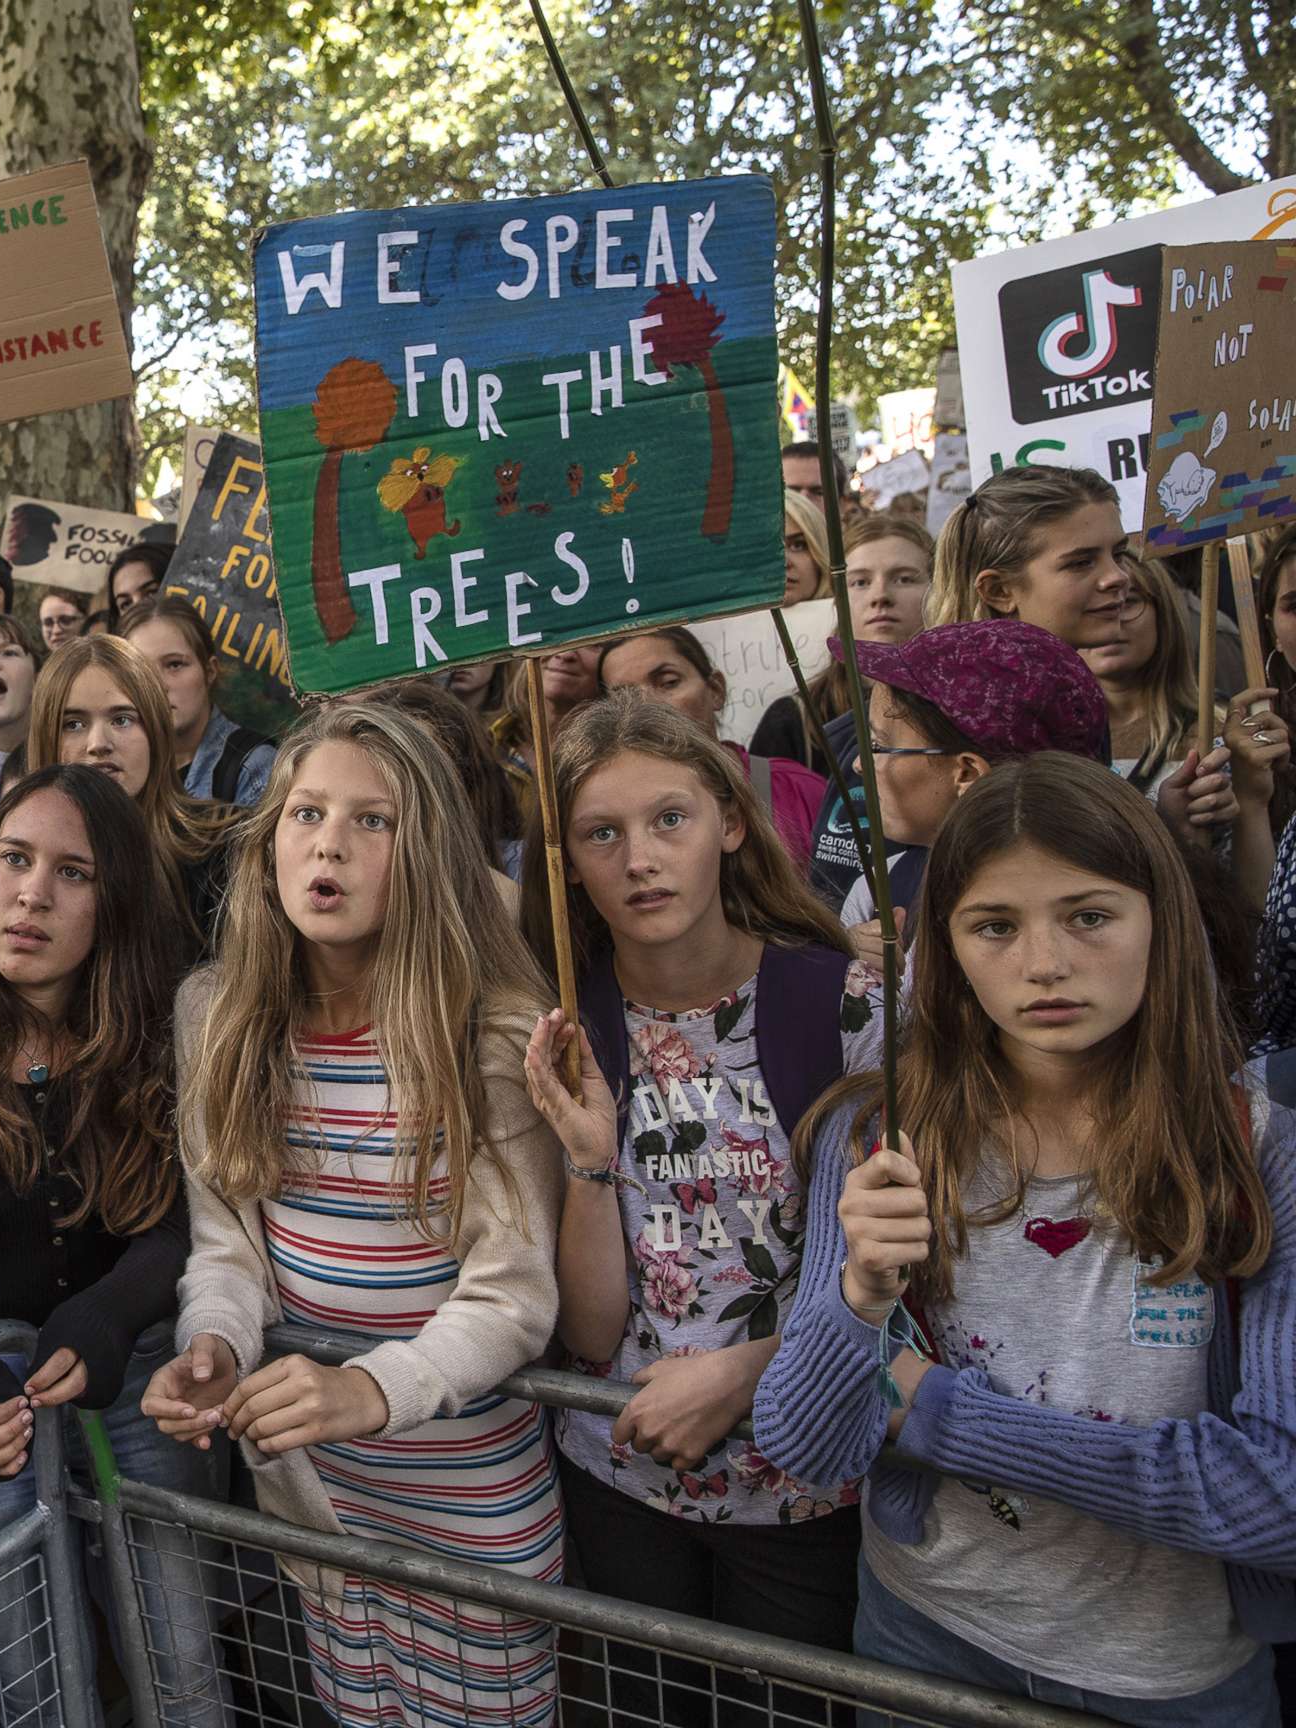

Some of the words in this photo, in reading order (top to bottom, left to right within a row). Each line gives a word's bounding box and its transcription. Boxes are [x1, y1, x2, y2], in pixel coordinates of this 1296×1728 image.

[277, 230, 422, 315] WE
[497, 200, 719, 301] SPEAK
[1170, 264, 1233, 313] POLAR
[1213, 323, 1253, 368] NOT
[404, 342, 508, 441] FOR
[542, 313, 668, 439] THE
[1041, 368, 1153, 410] TikTok
[628, 1077, 724, 1138] DAY
[736, 1077, 778, 1128] IS
[645, 1148, 770, 1180] FANTASTIC
[650, 1199, 772, 1252] DAY
